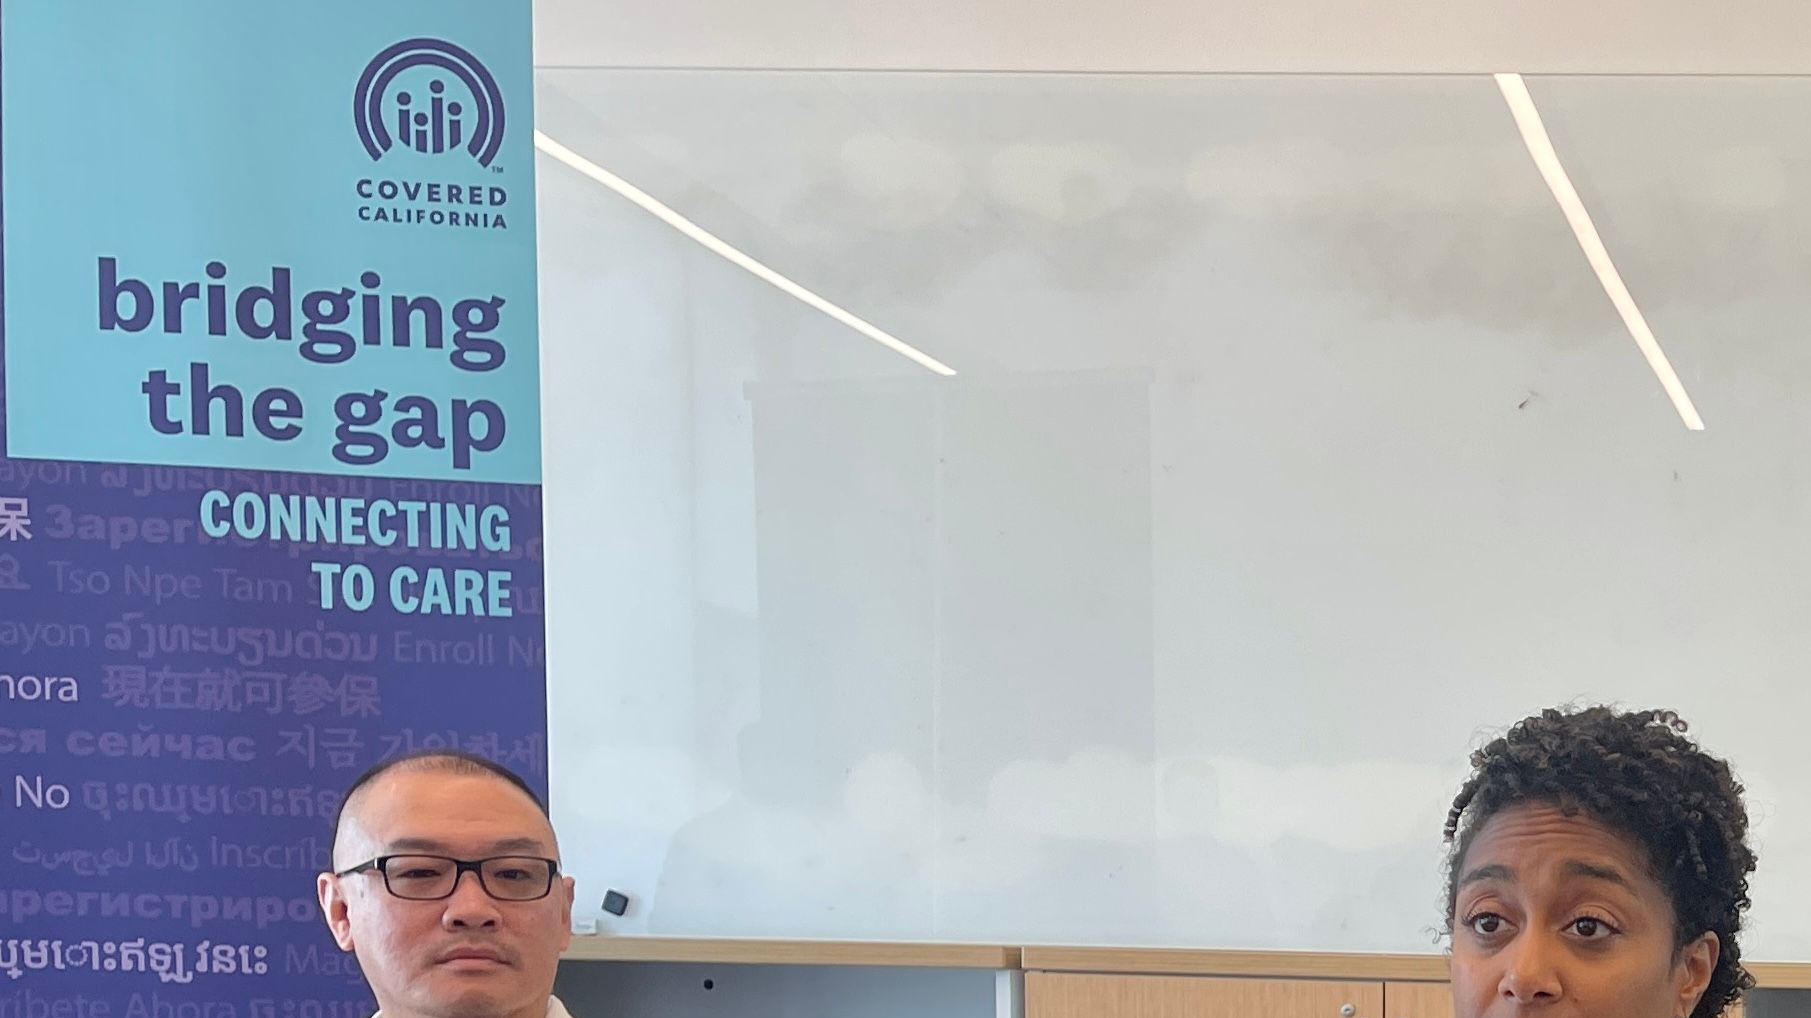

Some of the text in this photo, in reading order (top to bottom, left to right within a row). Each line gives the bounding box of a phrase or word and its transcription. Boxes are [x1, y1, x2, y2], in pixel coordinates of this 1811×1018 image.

[356, 179, 507, 207] COVERED
[358, 206, 507, 229] CALIFORNIA
[98, 256, 506, 372] bridging
[141, 362, 506, 470] the gap
[200, 489, 511, 552] CONNECTING
[48, 561, 110, 594] Tso
[124, 564, 200, 606] Npe
[212, 568, 293, 604] Tam
[311, 562, 375, 612] TO
[389, 565, 512, 618] CARE
[394, 630, 494, 665] Enroll
[66, 722, 256, 760] сейчас
[276, 723, 364, 770] 지금
[15, 774, 70, 809] No
